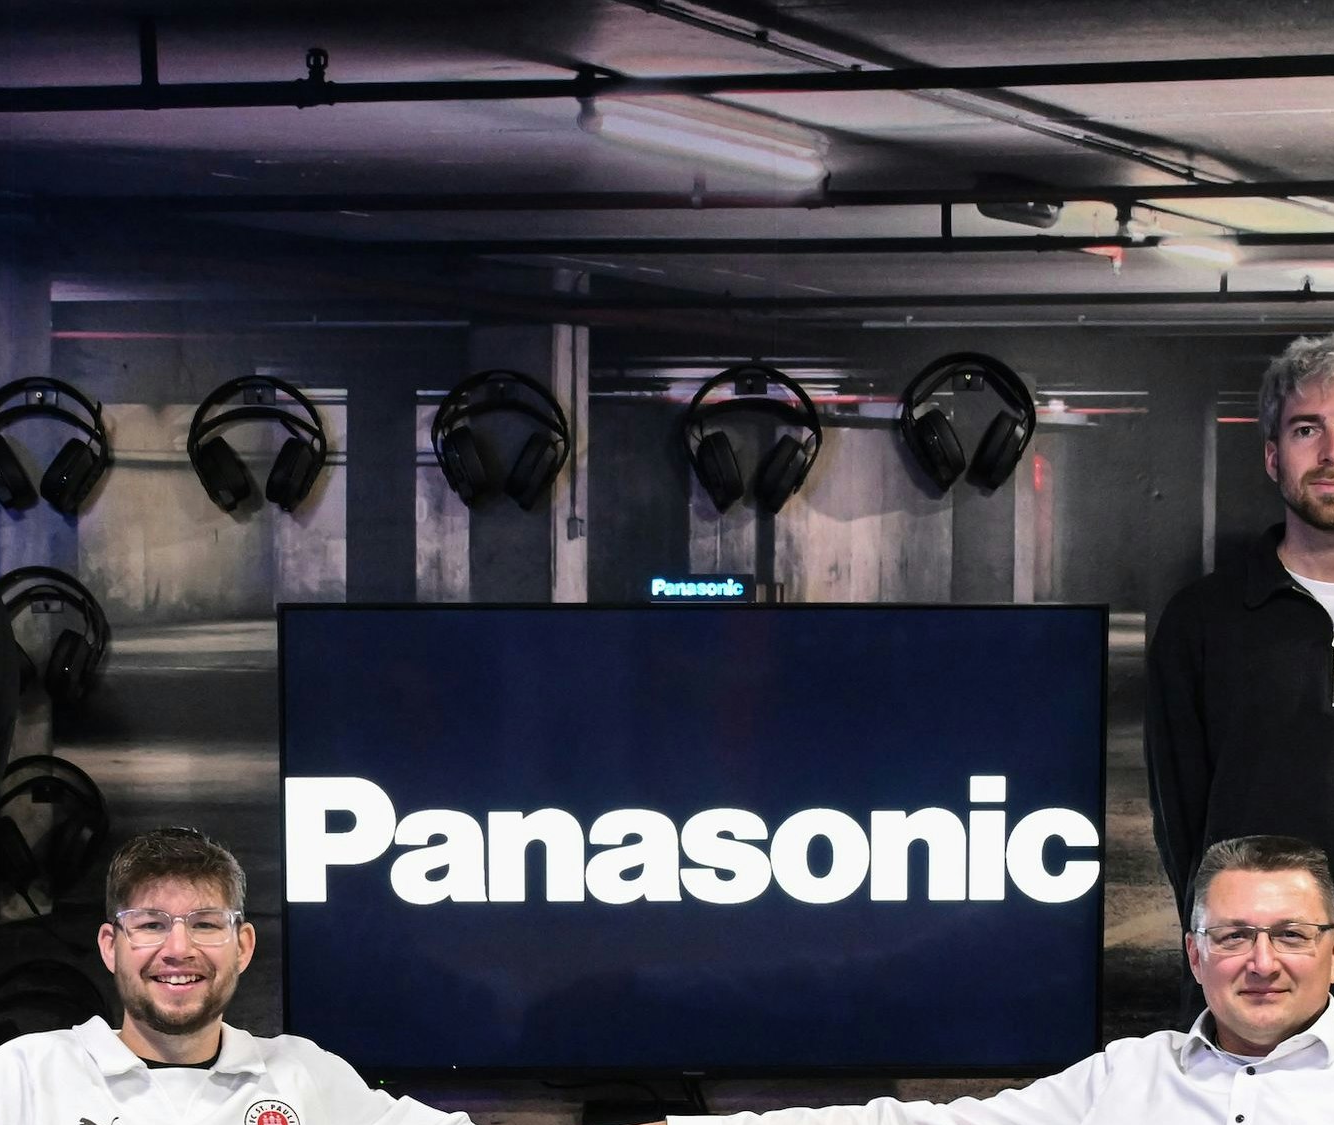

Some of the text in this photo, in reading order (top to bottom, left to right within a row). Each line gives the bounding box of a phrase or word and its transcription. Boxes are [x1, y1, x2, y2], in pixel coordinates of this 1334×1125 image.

[651, 578, 744, 597] Panasonic
[285, 775, 1100, 905] Panasonic
[249, 1114, 257, 1124] FC
[270, 1104, 295, 1124] PAULI
